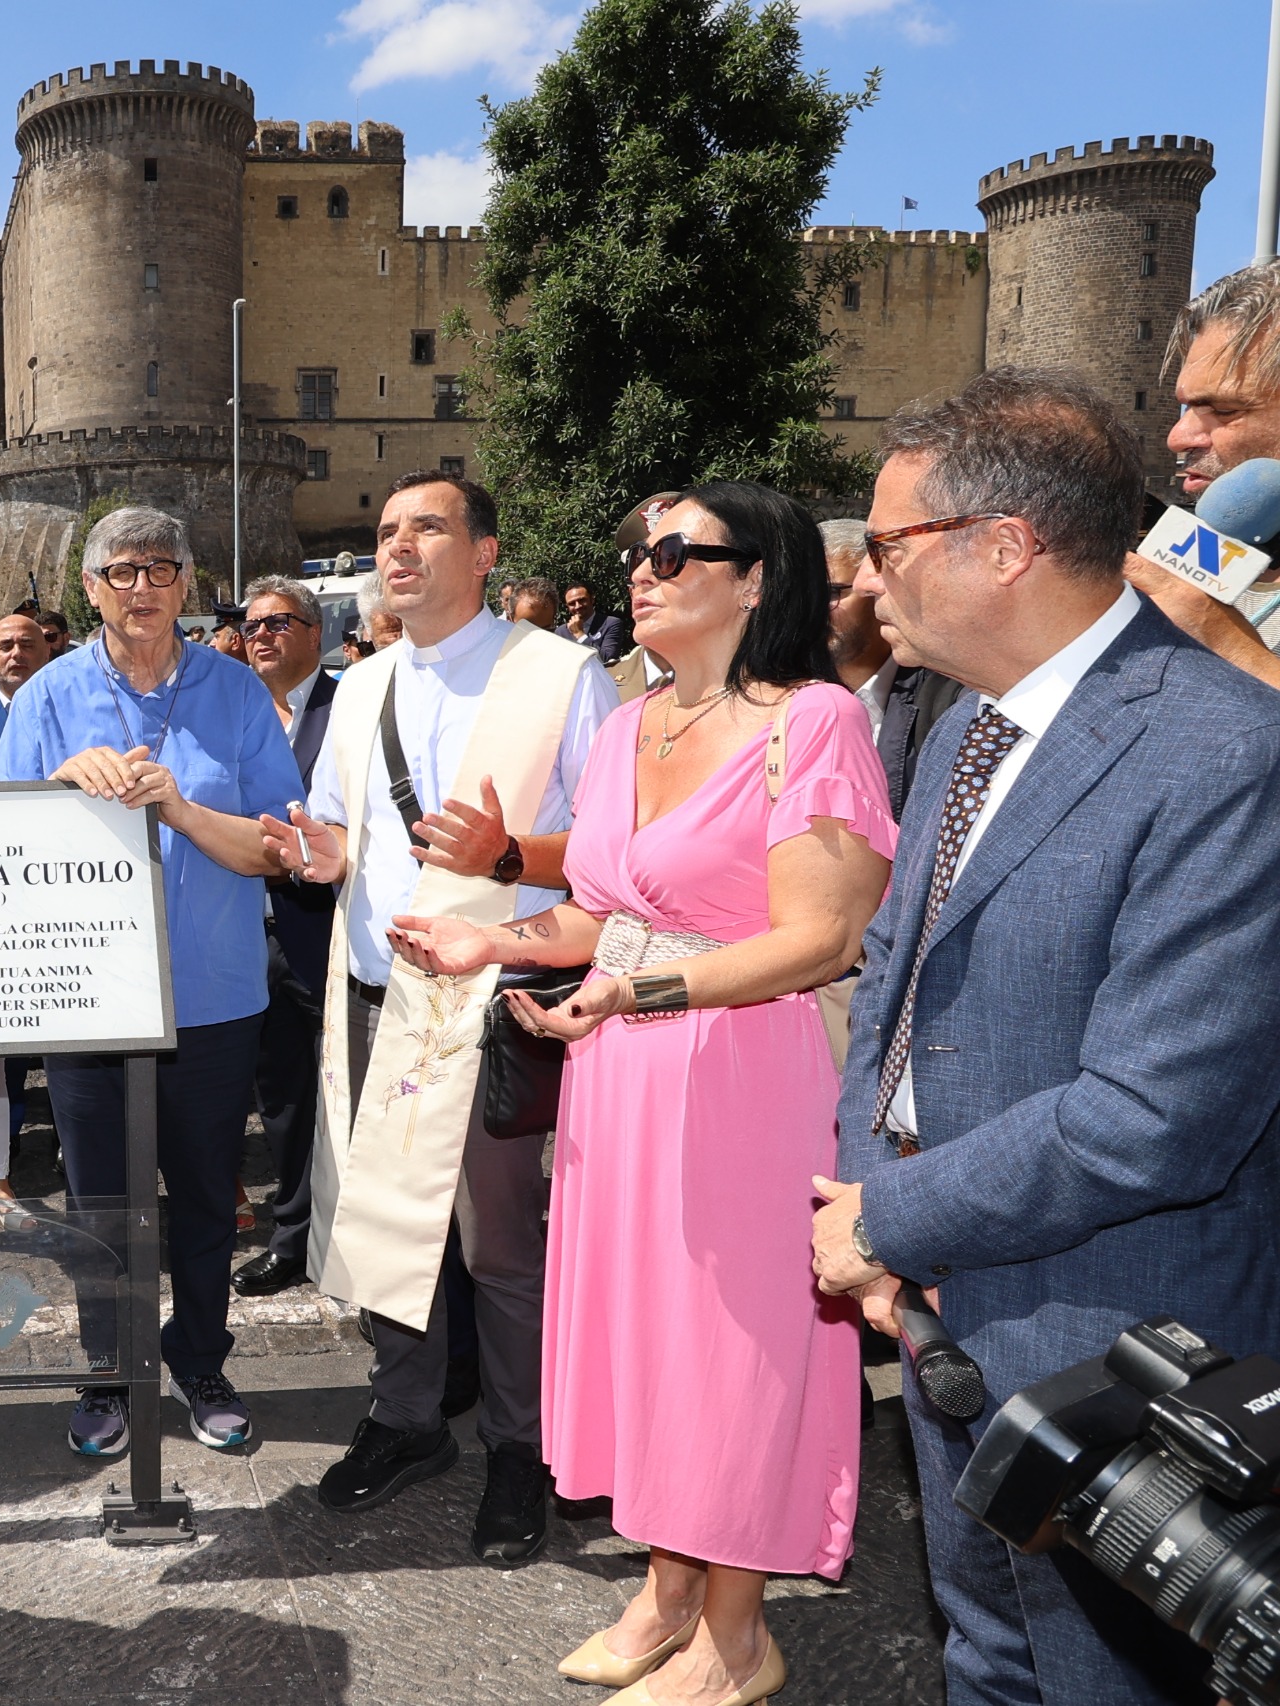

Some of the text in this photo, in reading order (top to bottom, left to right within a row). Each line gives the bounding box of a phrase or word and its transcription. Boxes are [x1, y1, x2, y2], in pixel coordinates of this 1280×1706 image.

[7, 845, 23, 857] DI
[23, 860, 133, 885] CUTOLO
[22, 917, 138, 934] CRIMINALITÀ
[51, 936, 110, 948] CIVILE
[36, 965, 93, 977] ANIMA
[18, 981, 81, 994] CORNO
[29, 997, 100, 1010] SEMPRE
